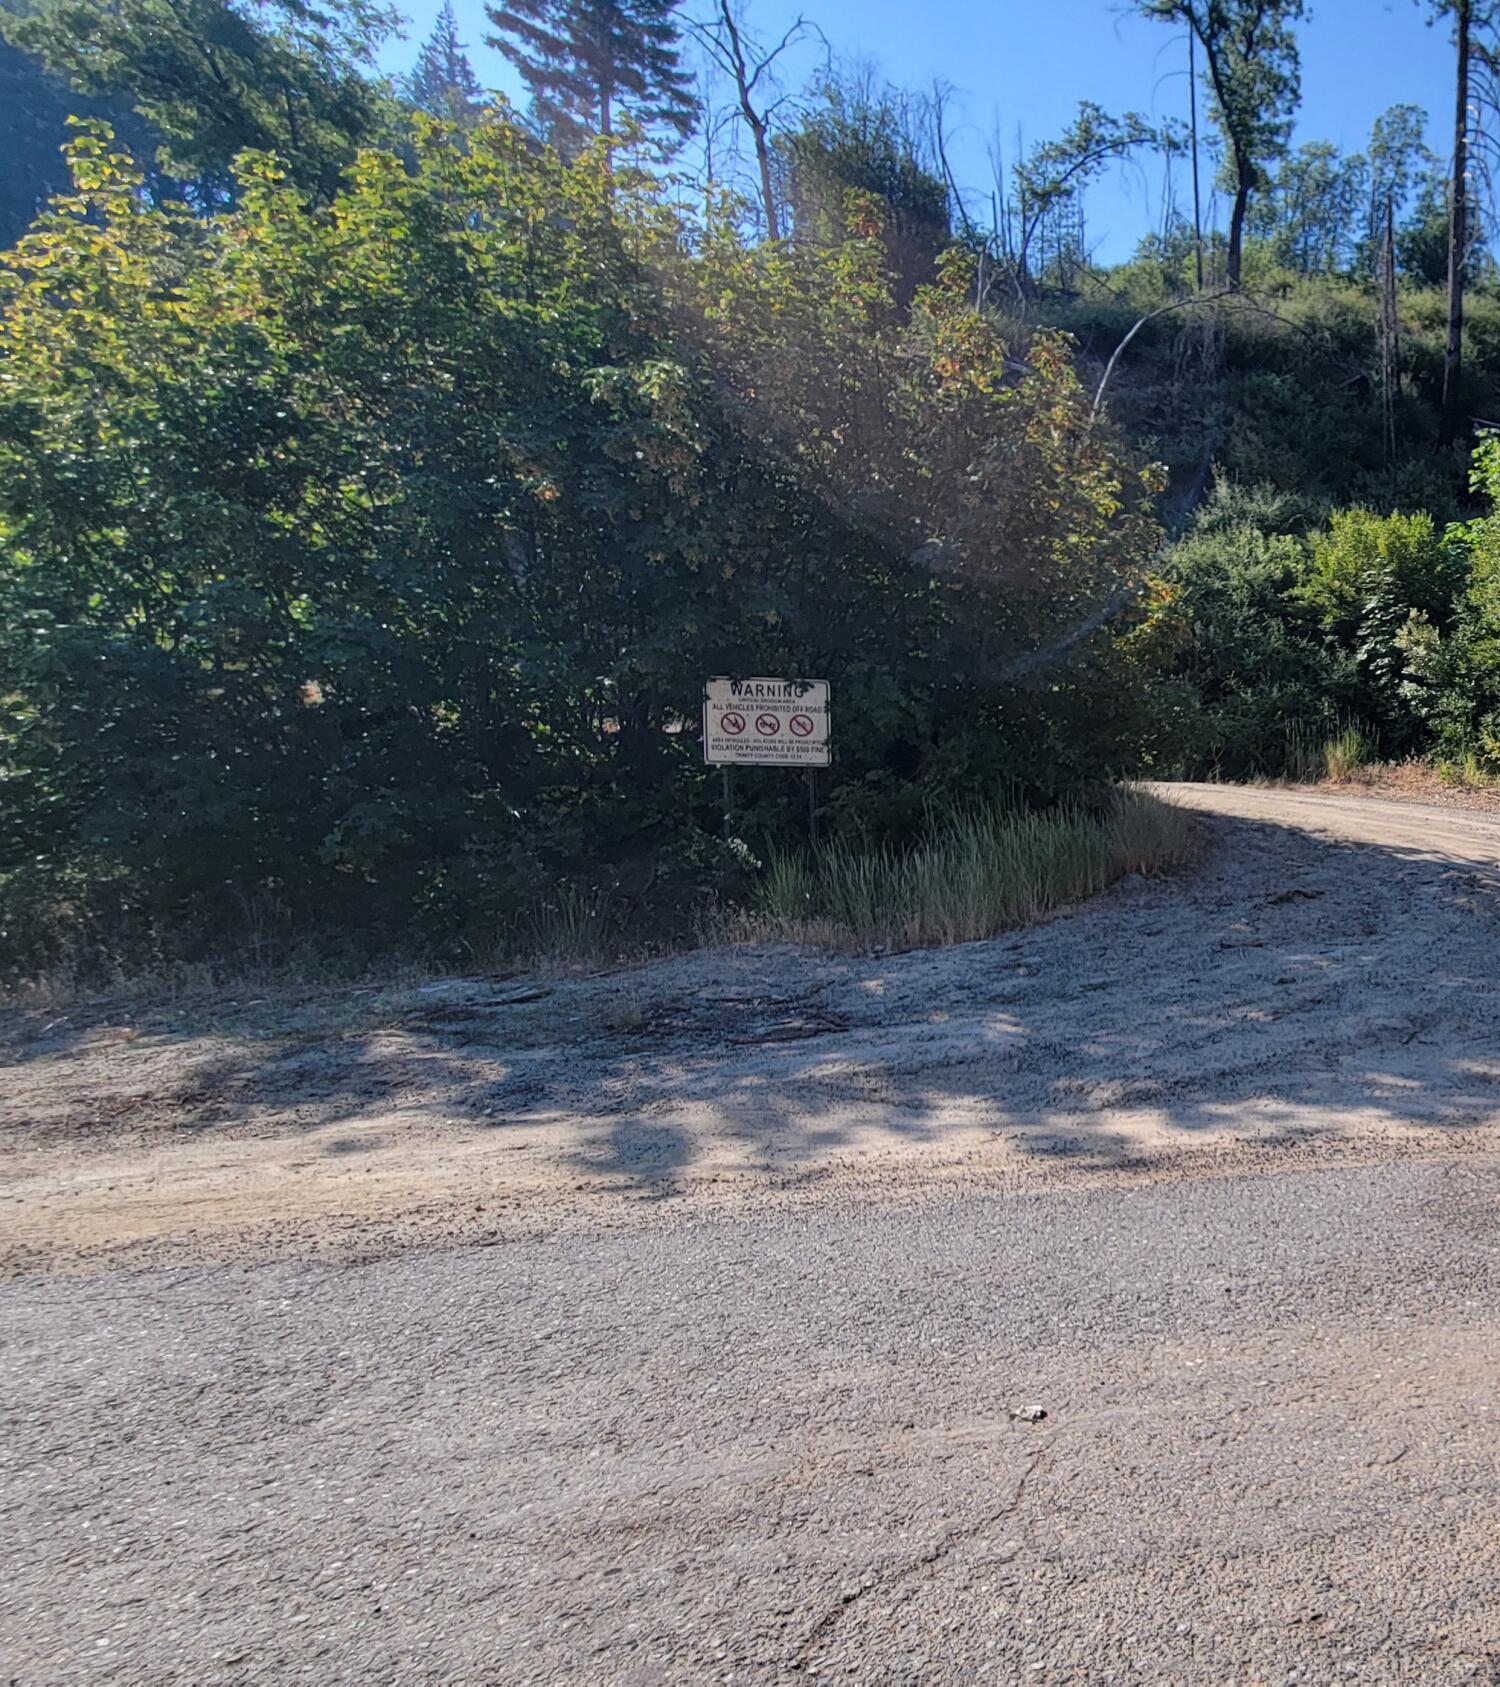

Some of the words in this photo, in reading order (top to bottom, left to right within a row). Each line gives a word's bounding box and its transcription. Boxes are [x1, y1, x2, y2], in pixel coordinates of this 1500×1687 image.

[730, 682, 804, 698] WARNING
[712, 703, 724, 711] ALL
[725, 703, 755, 711] VEHICLES
[755, 704, 791, 712] PROHIBITED
[805, 706, 822, 714] ROAD
